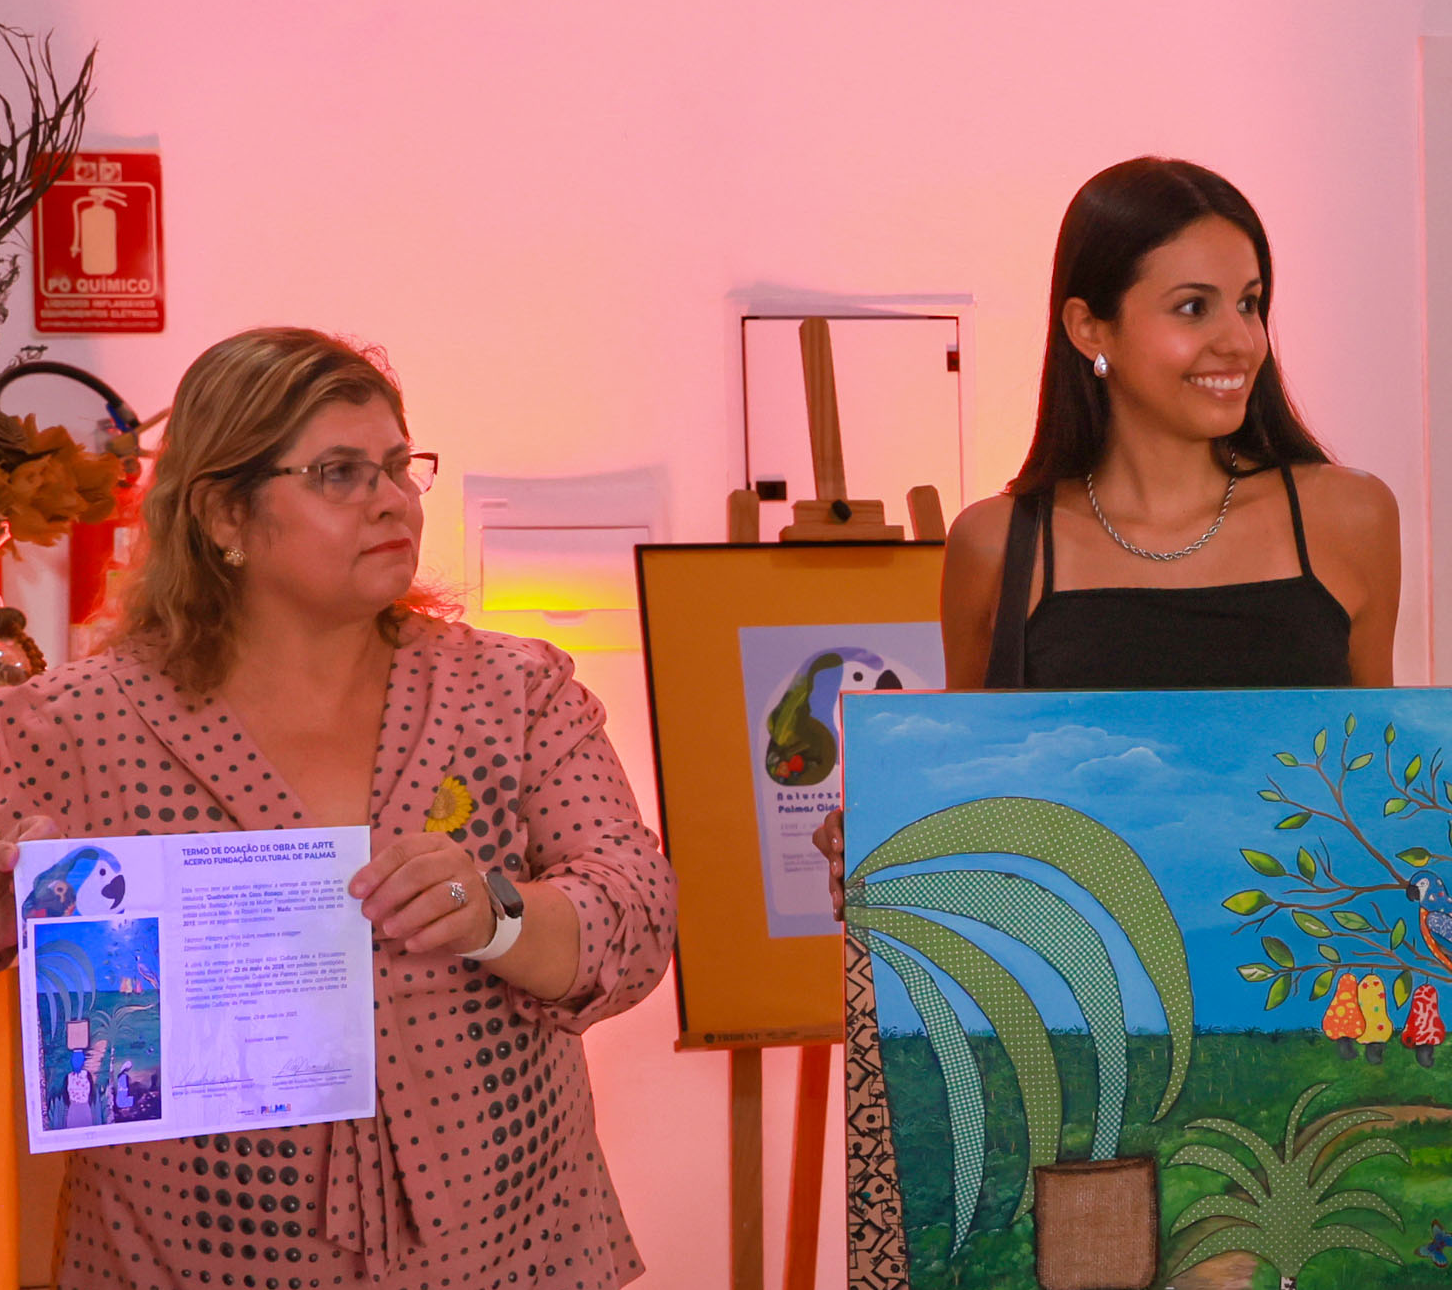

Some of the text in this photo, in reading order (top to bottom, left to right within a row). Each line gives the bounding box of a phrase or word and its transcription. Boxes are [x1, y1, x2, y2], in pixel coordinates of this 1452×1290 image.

[76, 276, 151, 292] QUÍMICO
[778, 804, 814, 813] Palmas
[182, 841, 335, 857] TERMO DE DOAÇÃO DE OBRA DE ARTE
[184, 851, 337, 866] ACERVO FUNDAÇÃO CULTURAL DE PALMAS
